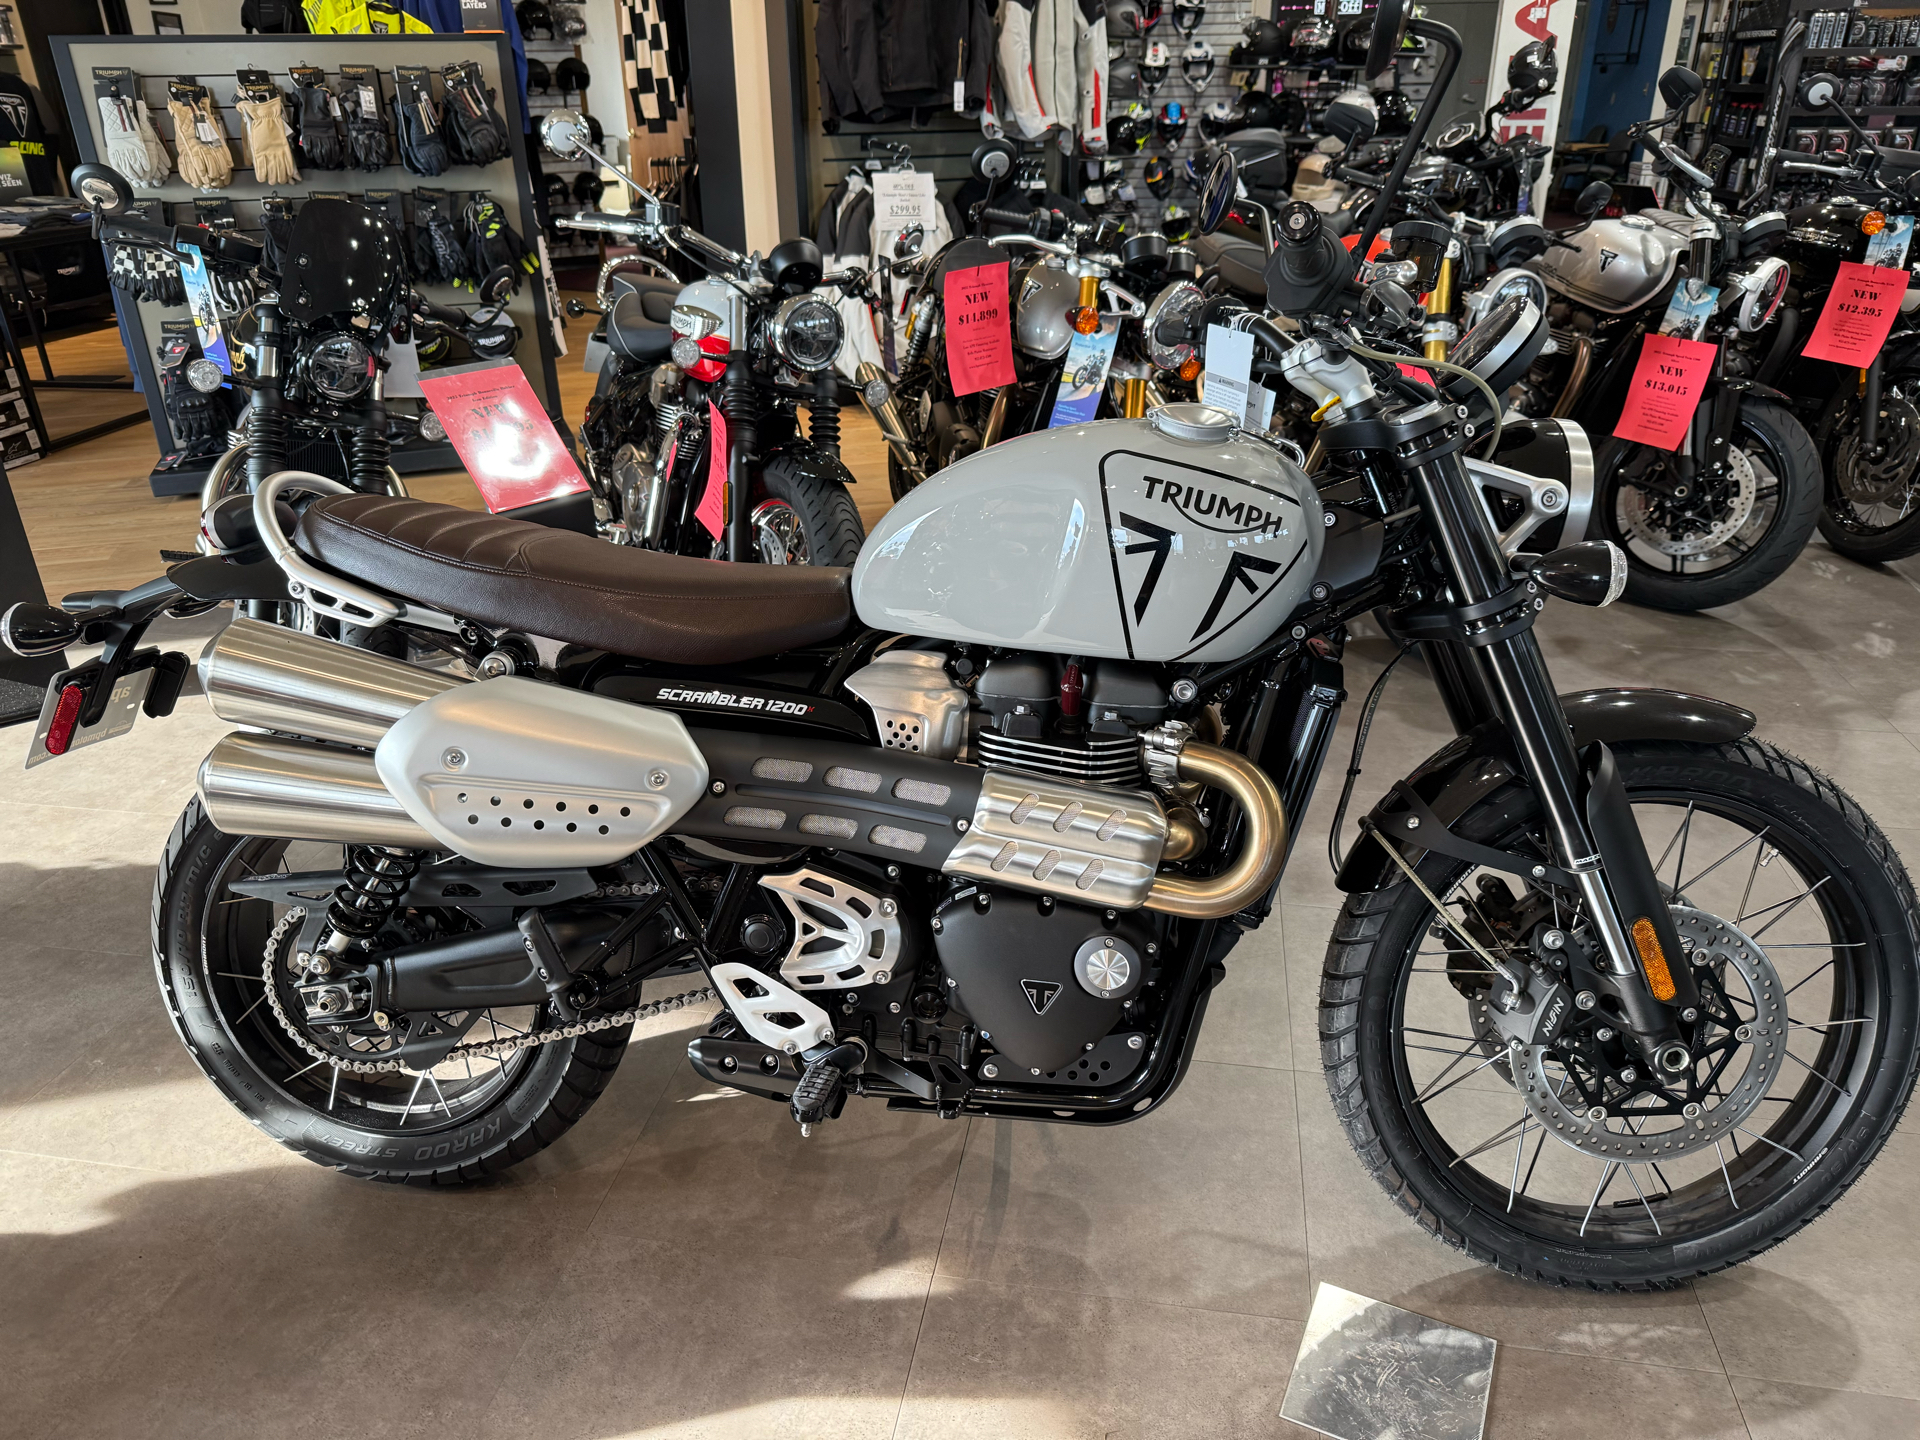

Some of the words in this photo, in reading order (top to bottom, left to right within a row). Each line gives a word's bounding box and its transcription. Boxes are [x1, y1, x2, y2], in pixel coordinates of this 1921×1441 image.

[170, 82, 195, 91] TRIUMPH
[890, 205, 921, 215] $299.95
[965, 291, 990, 305] NEW
[1851, 289, 1882, 300] NEW
[478, 334, 505, 346] TRIUMPH
[1657, 365, 1687, 377] NEW
[1142, 476, 1283, 538] TRIUMPH
[656, 688, 764, 710] SCRAMBLER
[1542, 996, 1564, 1036] NISSIN
[322, 1132, 399, 1158] STREET
[414, 1118, 500, 1160] KAROO
